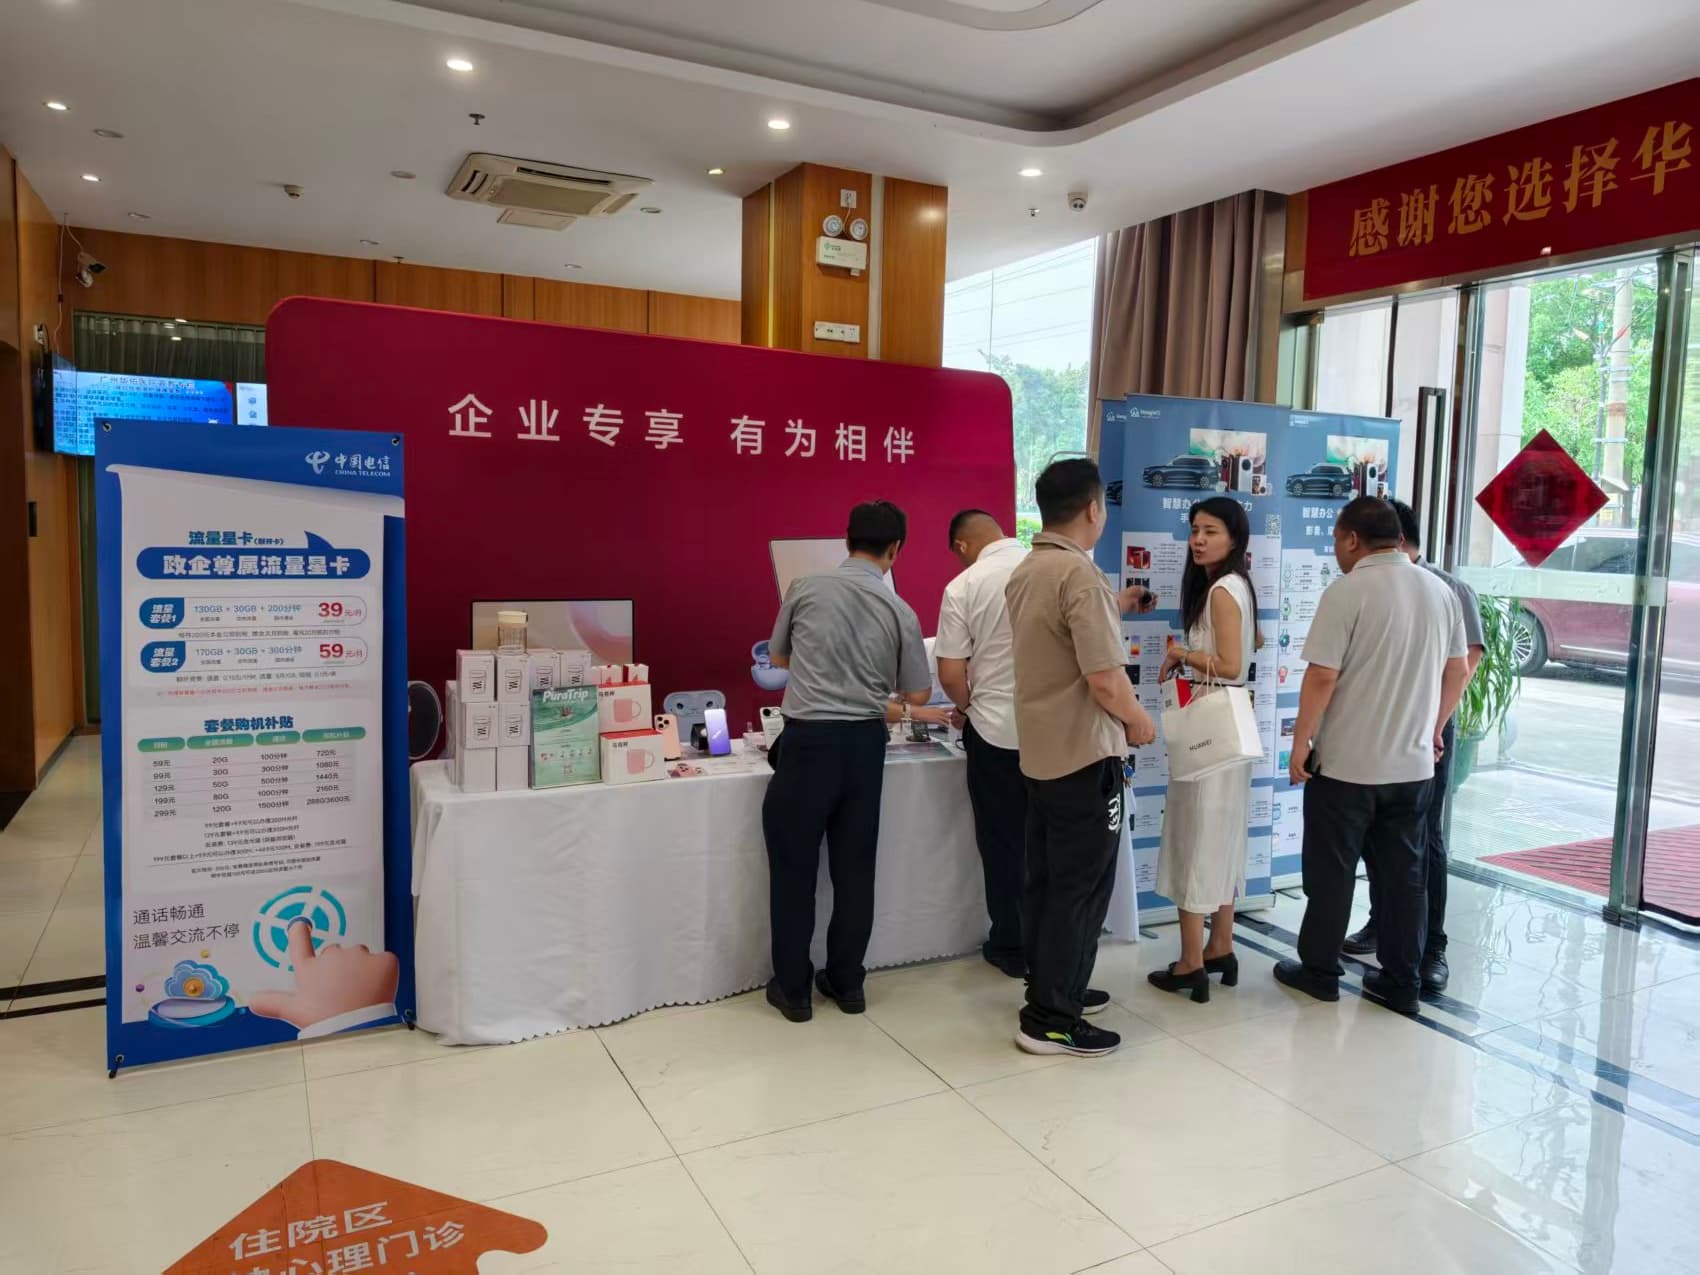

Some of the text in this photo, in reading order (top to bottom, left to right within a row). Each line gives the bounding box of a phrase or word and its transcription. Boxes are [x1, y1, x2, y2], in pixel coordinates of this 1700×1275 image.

[1349, 120, 1693, 257] 感谢您选择华
[447, 393, 915, 464] 企业专享 有为相伴
[334, 452, 391, 470] 中国电信
[188, 530, 253, 546] 流量星卡
[162, 554, 351, 576] 政企尊属流量星卡
[193, 604, 223, 614] 130GB
[233, 604, 257, 614] 30GB
[318, 602, 343, 618] 39
[196, 647, 224, 657] 170GB
[319, 643, 344, 659] 59
[203, 715, 294, 733] 套餐购机补贴
[1189, 739, 1213, 751] HUAWEI
[212, 756, 229, 764] 20G
[260, 752, 288, 761] 100分钟
[316, 749, 337, 757] 720元
[212, 769, 229, 777] 30G
[153, 784, 175, 792] 129元
[260, 777, 289, 785] 500分钟
[154, 796, 176, 805] 199元
[154, 809, 177, 817] 299元
[212, 805, 232, 813] 120G
[133, 903, 206, 925] 通话畅通
[133, 922, 240, 950] 温馨交流不停
[229, 1200, 393, 1261] 住院区
[230, 1220, 465, 1275] 心理门诊
